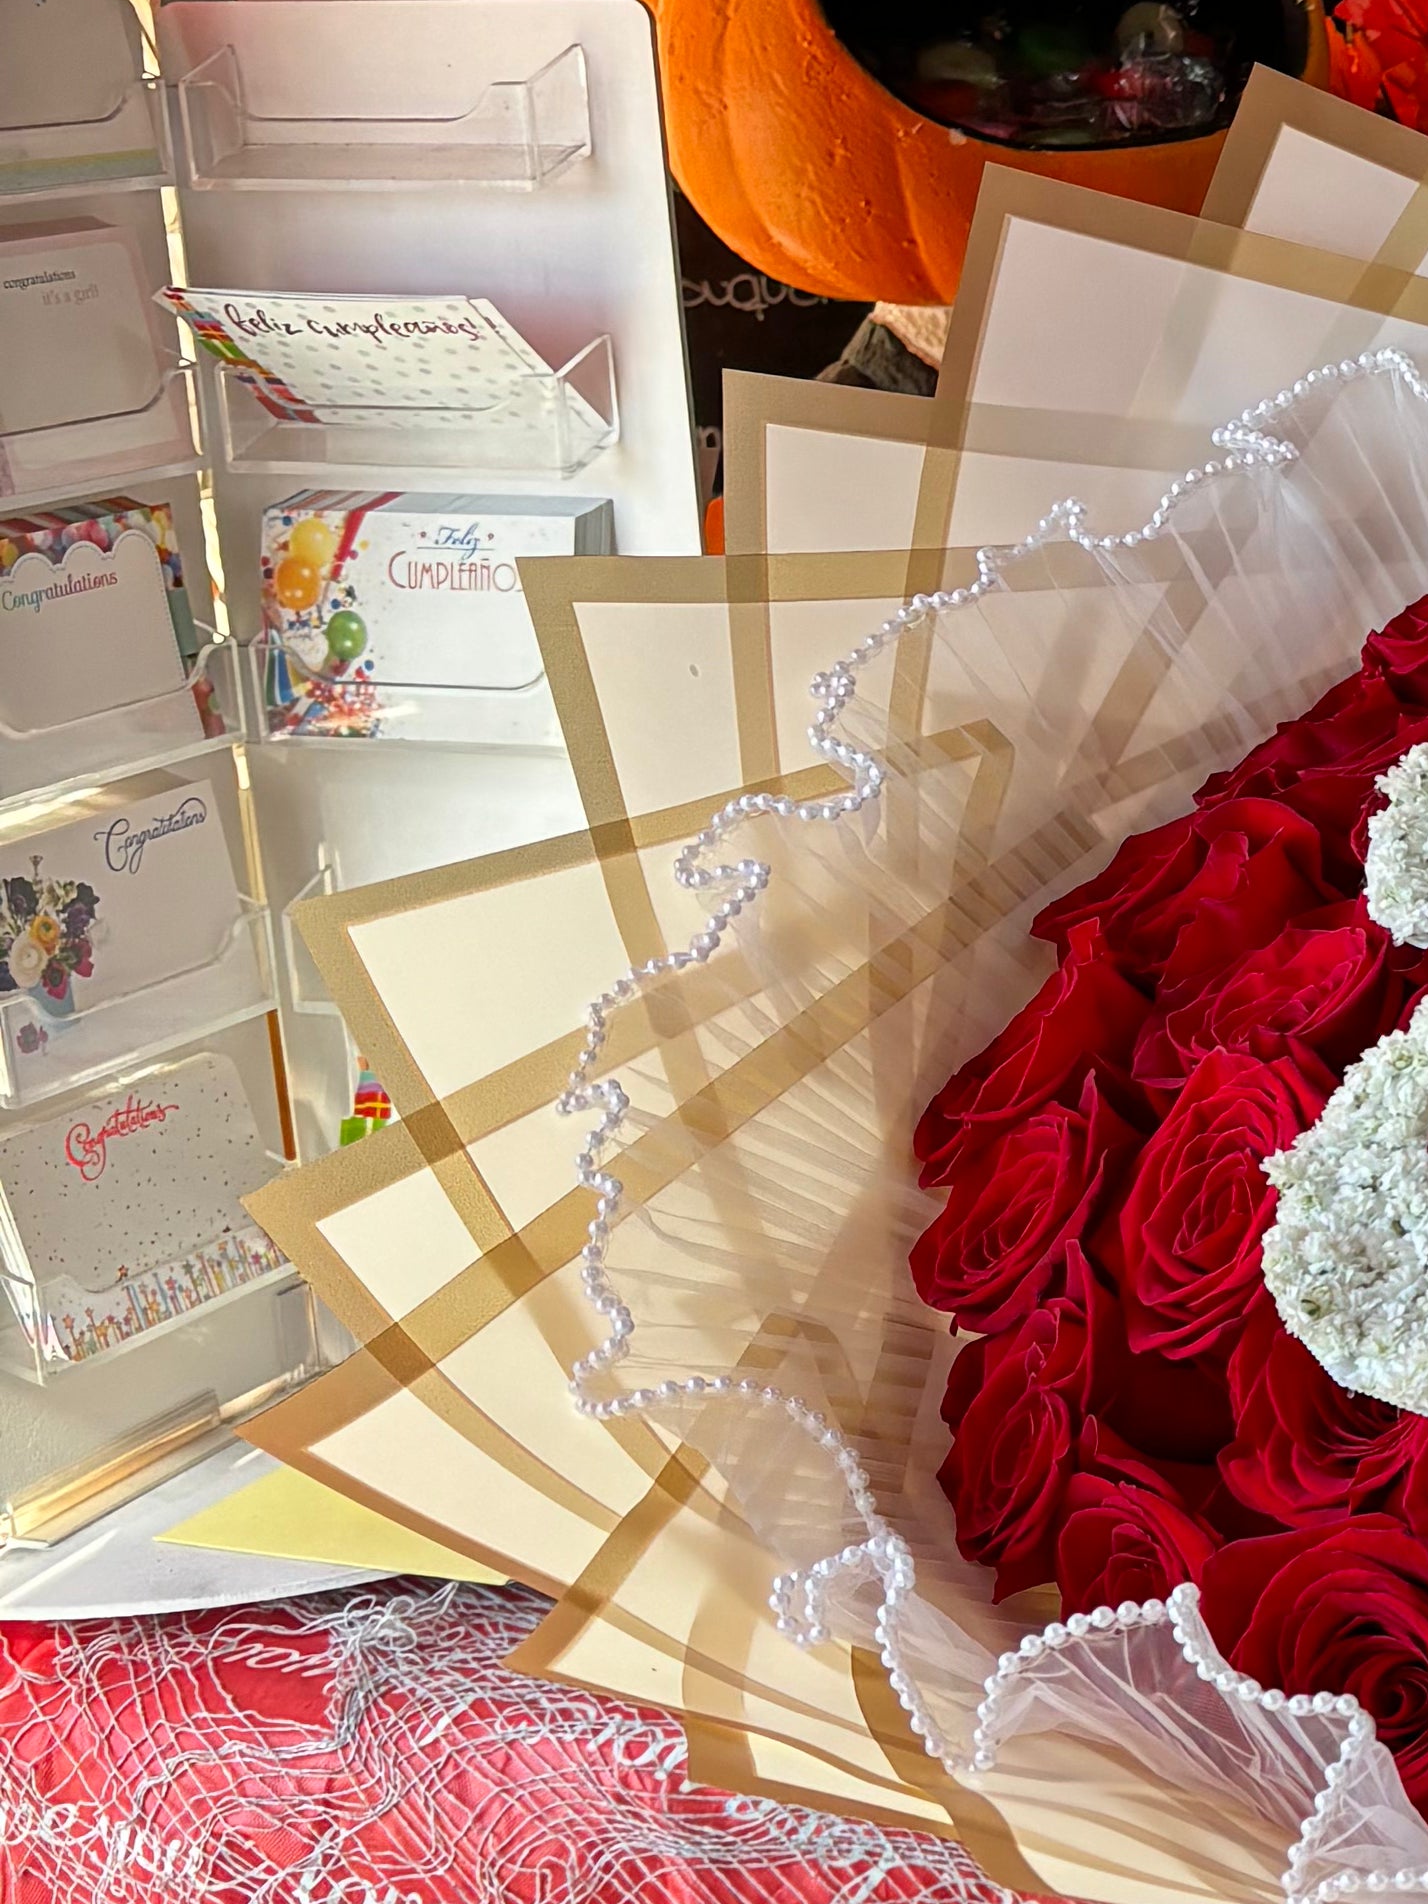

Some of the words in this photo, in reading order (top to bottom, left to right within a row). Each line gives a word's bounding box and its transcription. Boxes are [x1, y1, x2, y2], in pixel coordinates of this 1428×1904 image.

[3, 270, 77, 290] congratulations
[434, 521, 482, 561] Feliz
[1, 571, 118, 614] Congratulations
[388, 550, 524, 593] CUMPLEAÑO
[65, 1093, 180, 1182] Congratulations
